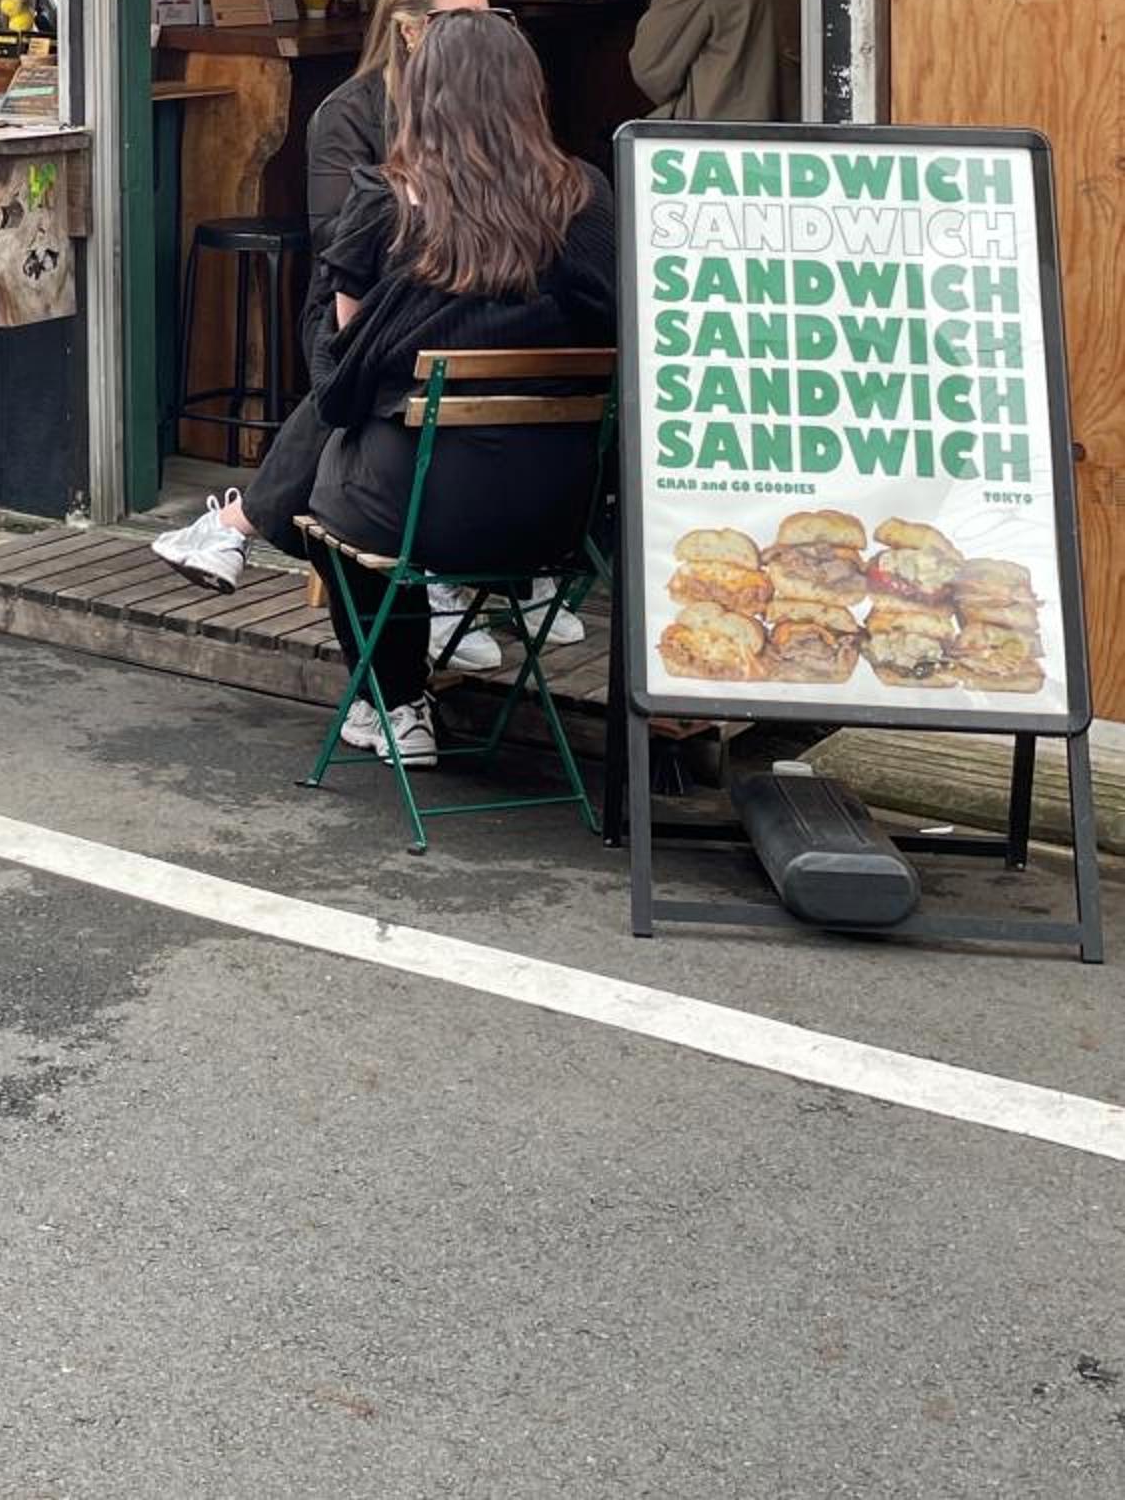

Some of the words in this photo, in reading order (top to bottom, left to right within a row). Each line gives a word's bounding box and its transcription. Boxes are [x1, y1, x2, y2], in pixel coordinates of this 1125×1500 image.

[650, 149, 1013, 205] SANDWICH
[650, 201, 1018, 260] SANDWICH
[652, 256, 1020, 313] SANDWICH
[653, 309, 1024, 369] SANDWICH
[654, 364, 1028, 425] SANDWICH
[656, 420, 1032, 482] SANDWICH
[656, 477, 697, 490] GRAB
[701, 480, 727, 491] and
[731, 481, 750, 492] GO
[754, 482, 816, 495] GOODIES
[983, 491, 1033, 505] TOKYO
